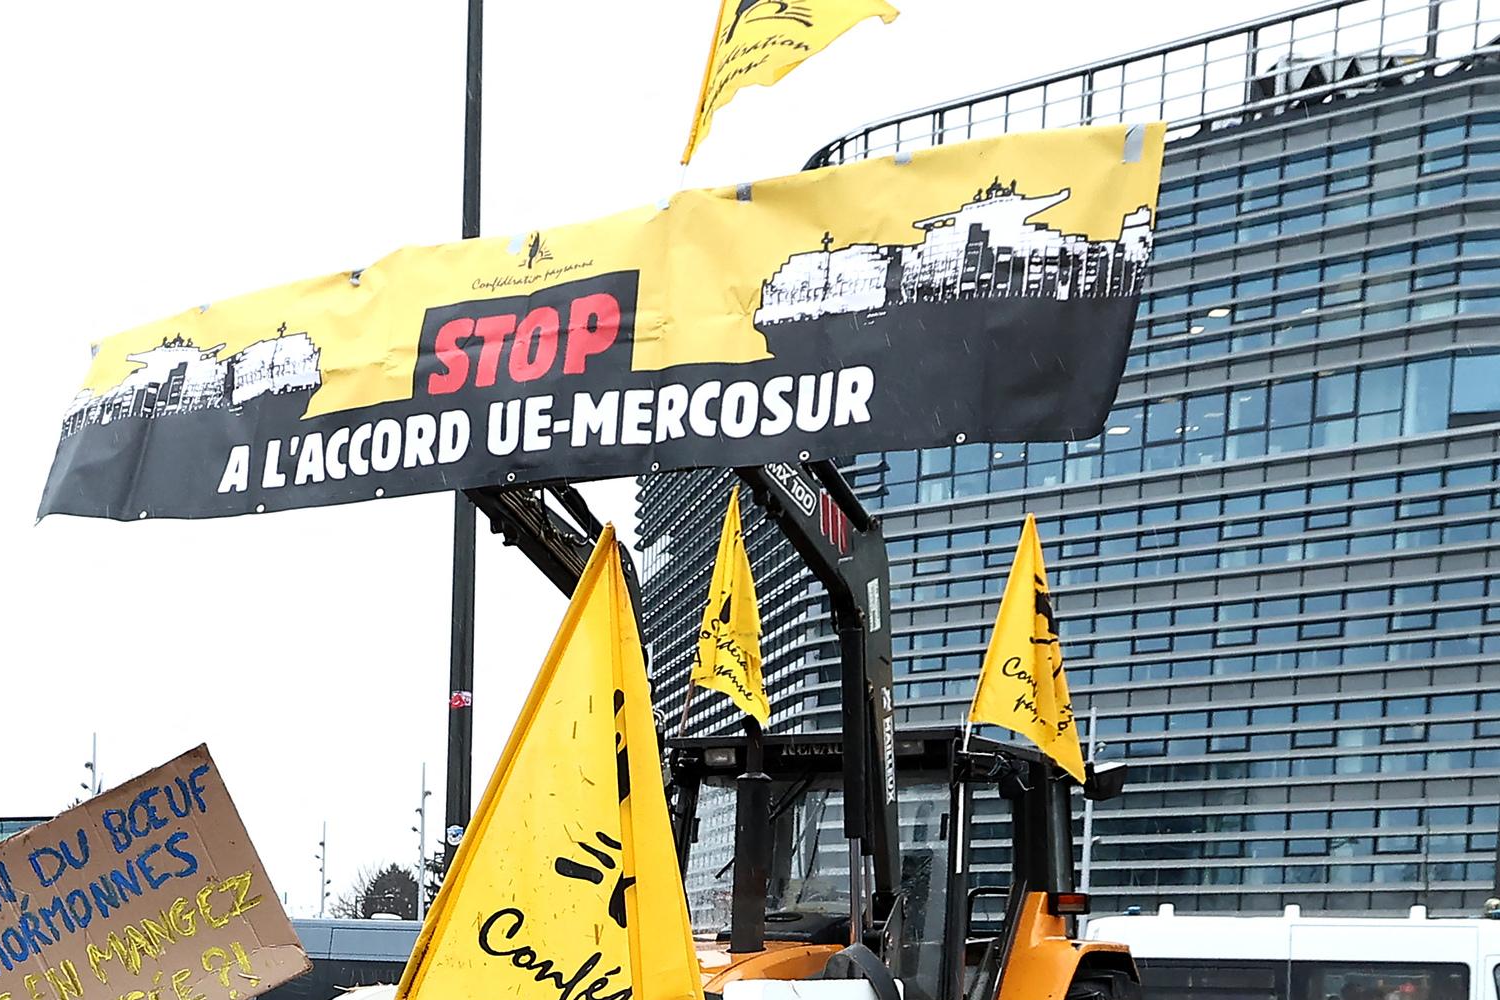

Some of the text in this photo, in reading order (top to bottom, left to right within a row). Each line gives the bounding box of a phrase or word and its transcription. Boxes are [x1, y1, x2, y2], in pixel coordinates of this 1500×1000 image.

[427, 293, 621, 395] STOP
[217, 366, 874, 494] A L'ACCORD UE-MERCOSUR
[791, 478, 812, 511] 100
[29, 829, 90, 877] DU
[103, 763, 211, 853] BŒUF
